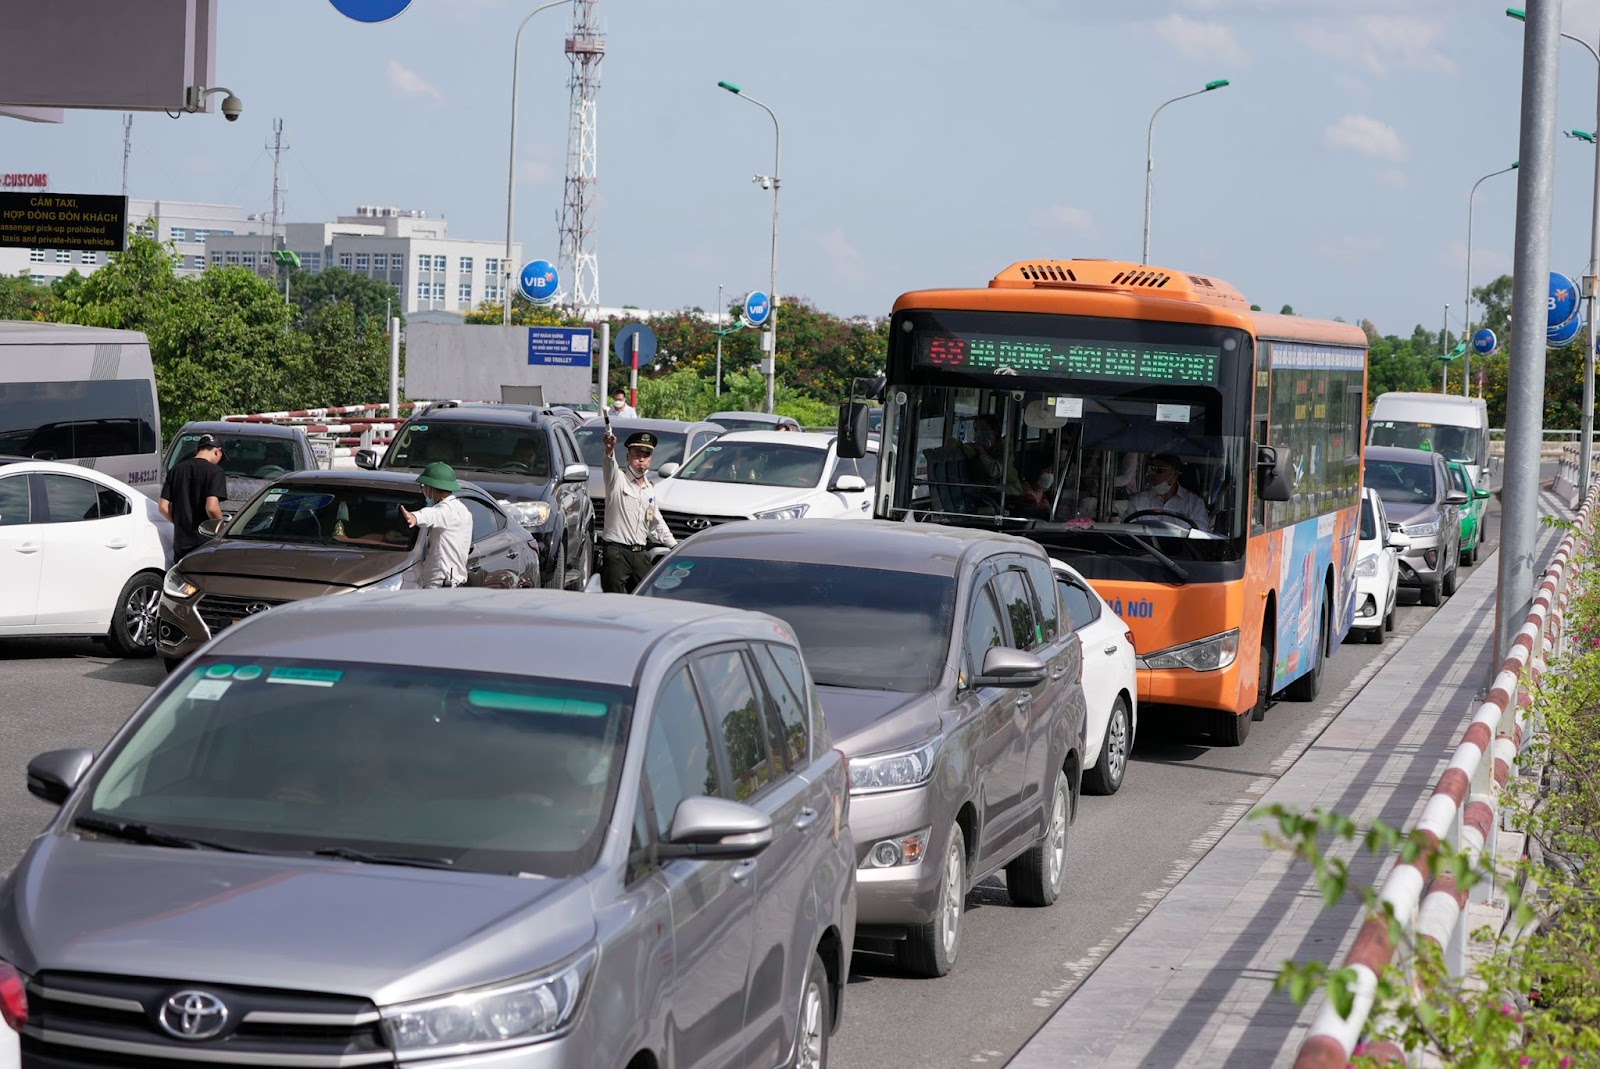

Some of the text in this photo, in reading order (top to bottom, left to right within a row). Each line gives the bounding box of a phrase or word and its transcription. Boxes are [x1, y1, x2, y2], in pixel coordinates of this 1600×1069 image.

[55, 198, 78, 209] TAXI,
[3, 209, 25, 221] HỢP
[58, 210, 80, 221] ĐÓN
[82, 211, 118, 223] KHÁCH
[37, 224, 65, 234] pick-up
[66, 225, 105, 235] prohibited
[2, 234, 115, 246] taxis and private-hire vehicles
[525, 277, 546, 287] VIB
[749, 306, 764, 314] VIB
[1068, 345, 1102, 374] NOI
[1104, 347, 1137, 376] BAI
[1139, 350, 1218, 382] AIRPORT
